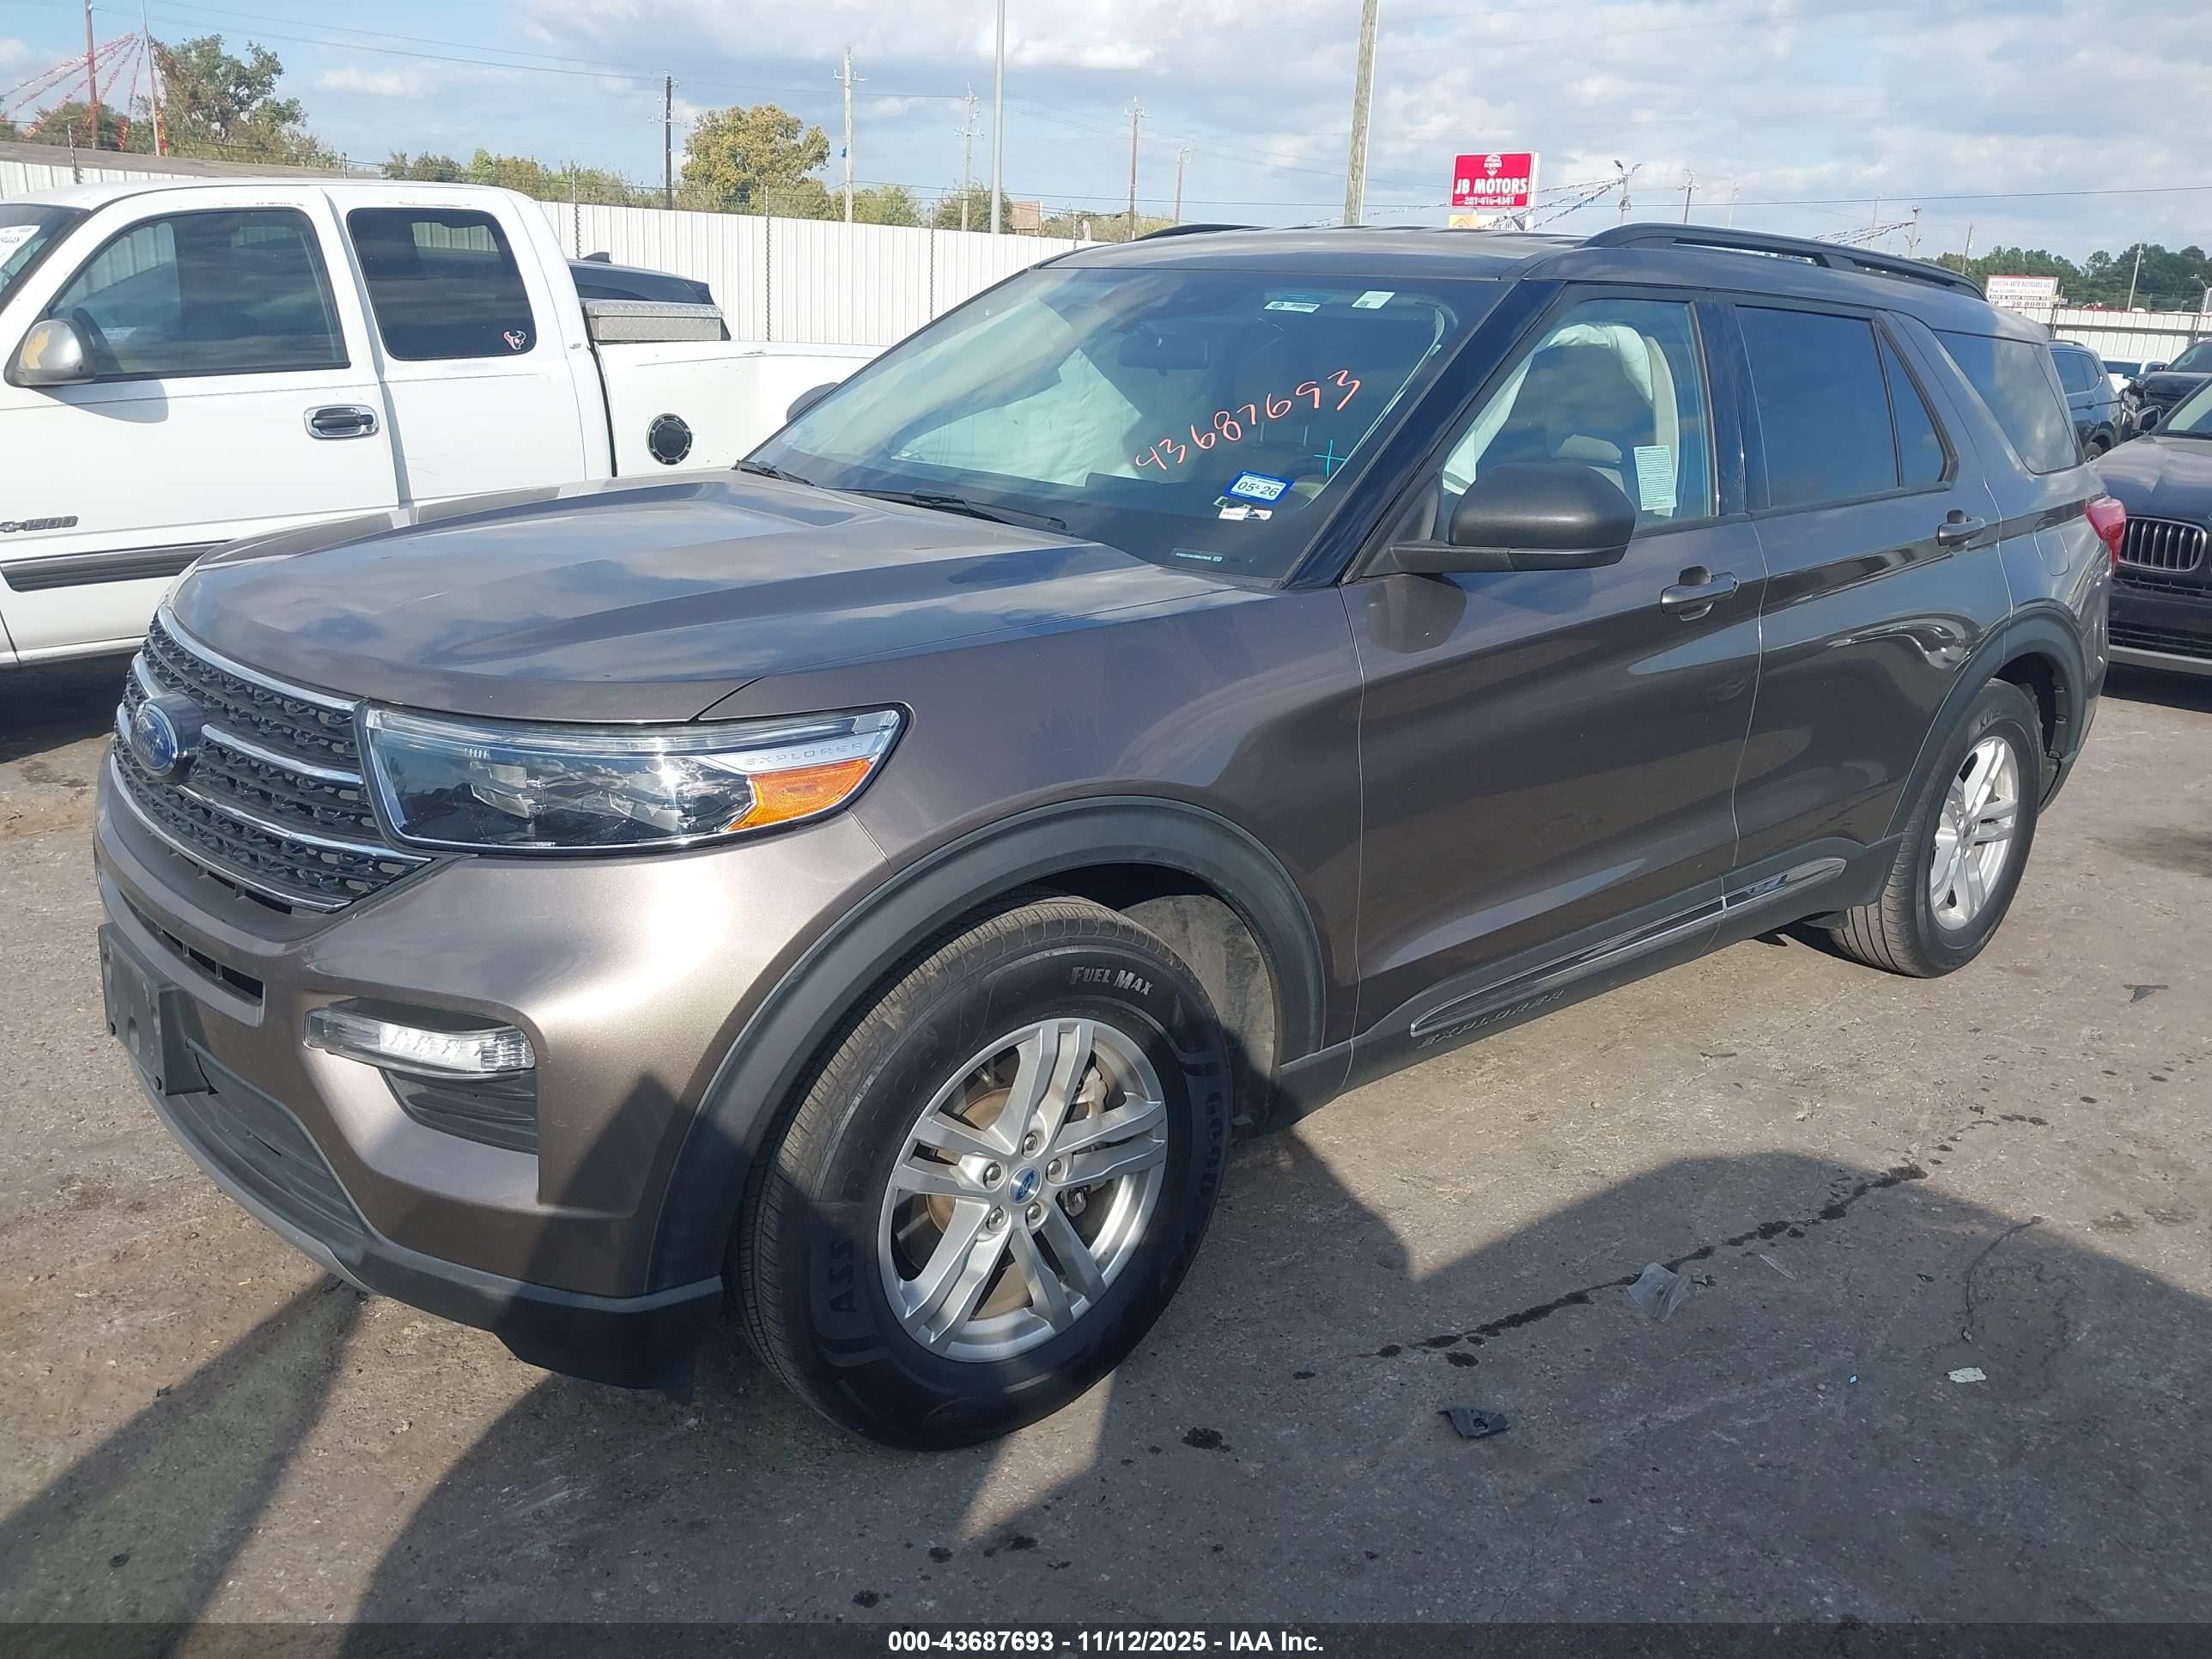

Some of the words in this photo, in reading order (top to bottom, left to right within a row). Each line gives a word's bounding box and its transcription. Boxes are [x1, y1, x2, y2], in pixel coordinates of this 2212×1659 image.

[1455, 179, 1471, 194] JB
[1474, 178, 1528, 194] MOTORS
[1135, 369, 1361, 471] 43687693
[1237, 482, 1256, 492] 05
[1260, 485, 1279, 497] 26
[25, 515, 79, 532] 1500
[744, 741, 864, 767] EXPLORER
